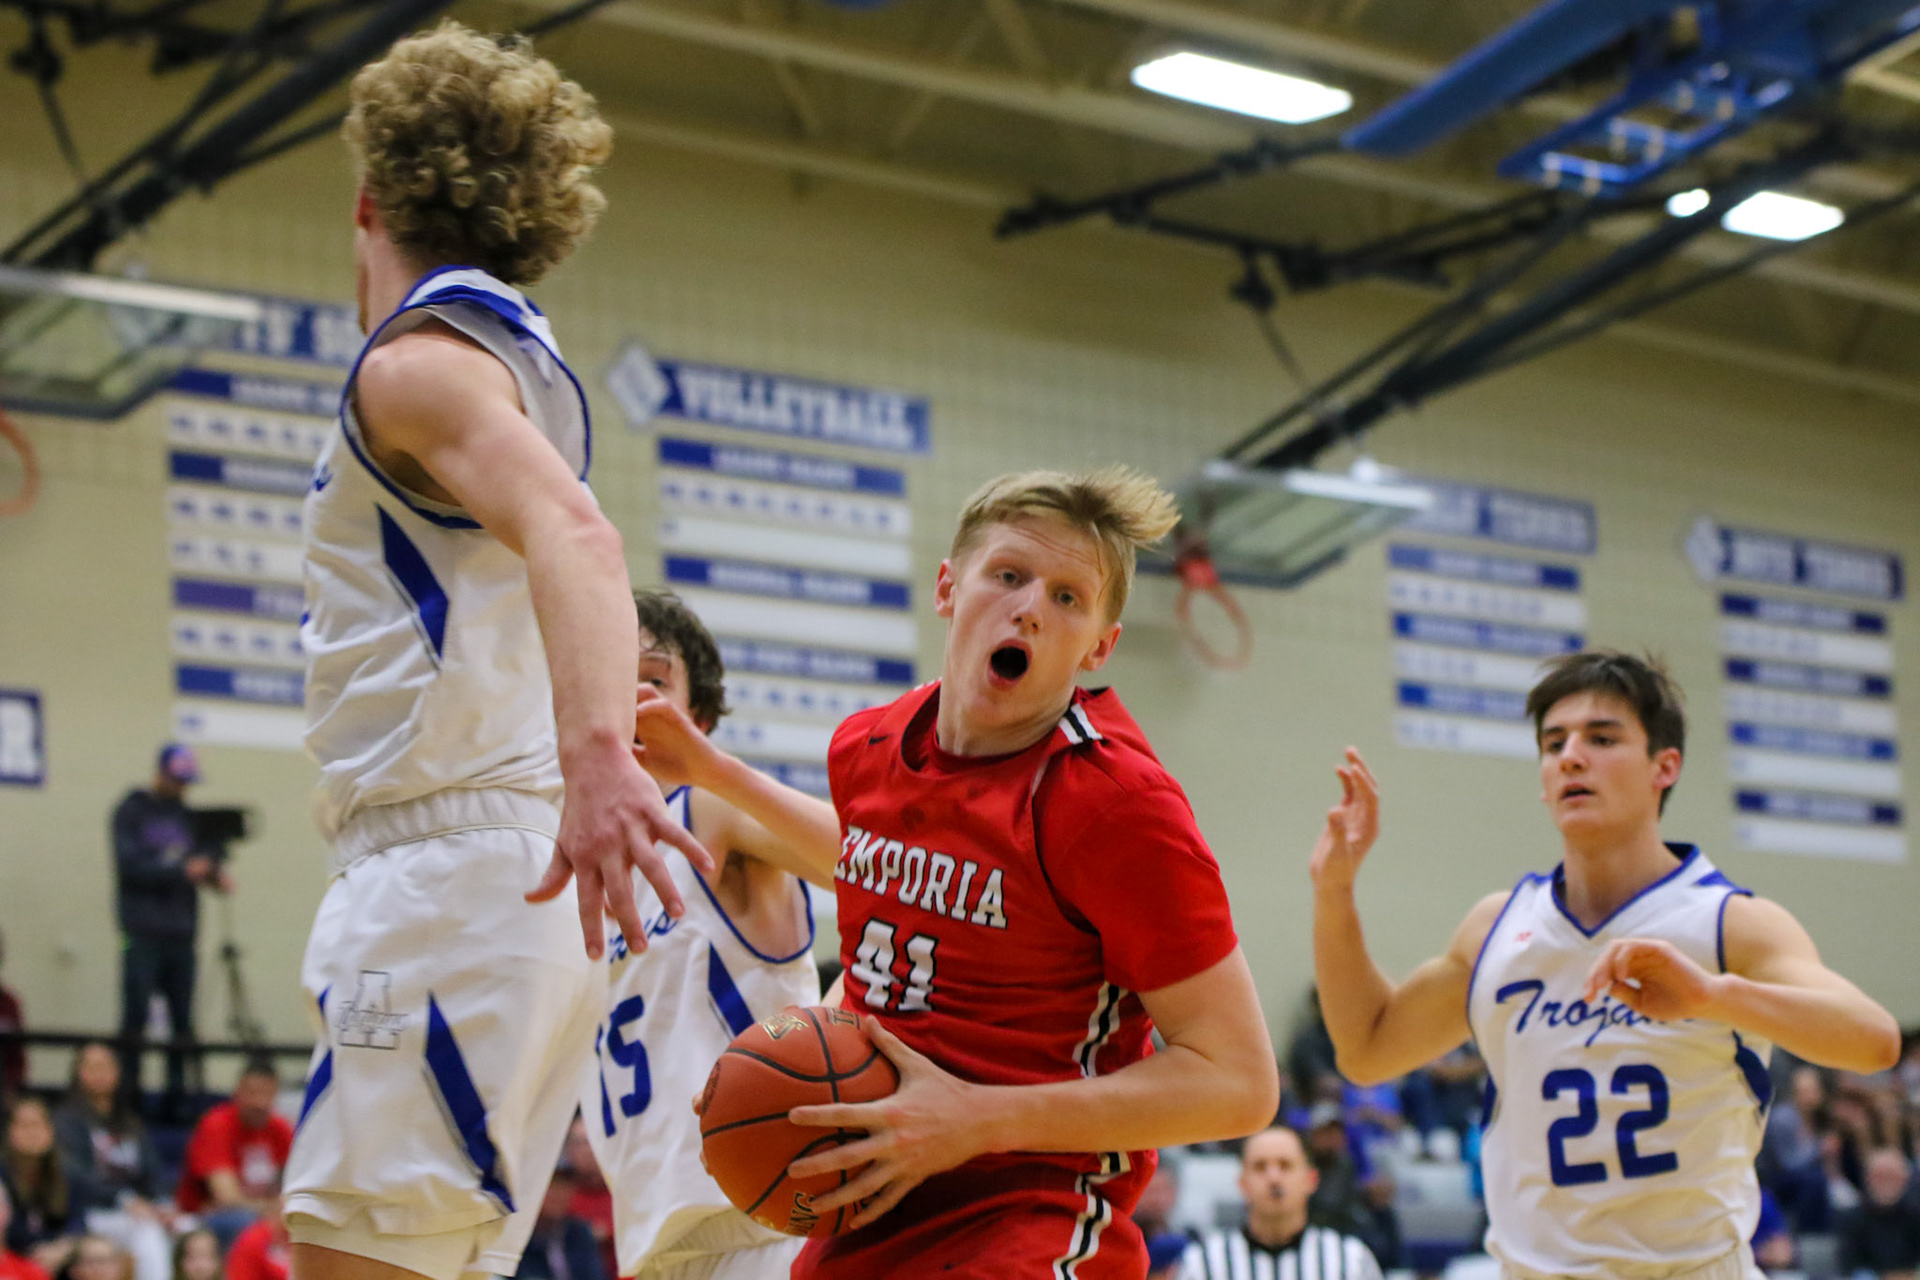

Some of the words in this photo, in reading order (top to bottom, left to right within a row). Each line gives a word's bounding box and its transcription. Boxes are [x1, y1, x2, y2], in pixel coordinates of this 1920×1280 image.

[834, 825, 1007, 929] EMPORIA
[850, 917, 938, 1012] 41
[1495, 979, 1697, 1048] Troja
[1541, 1063, 1679, 1187] 22
